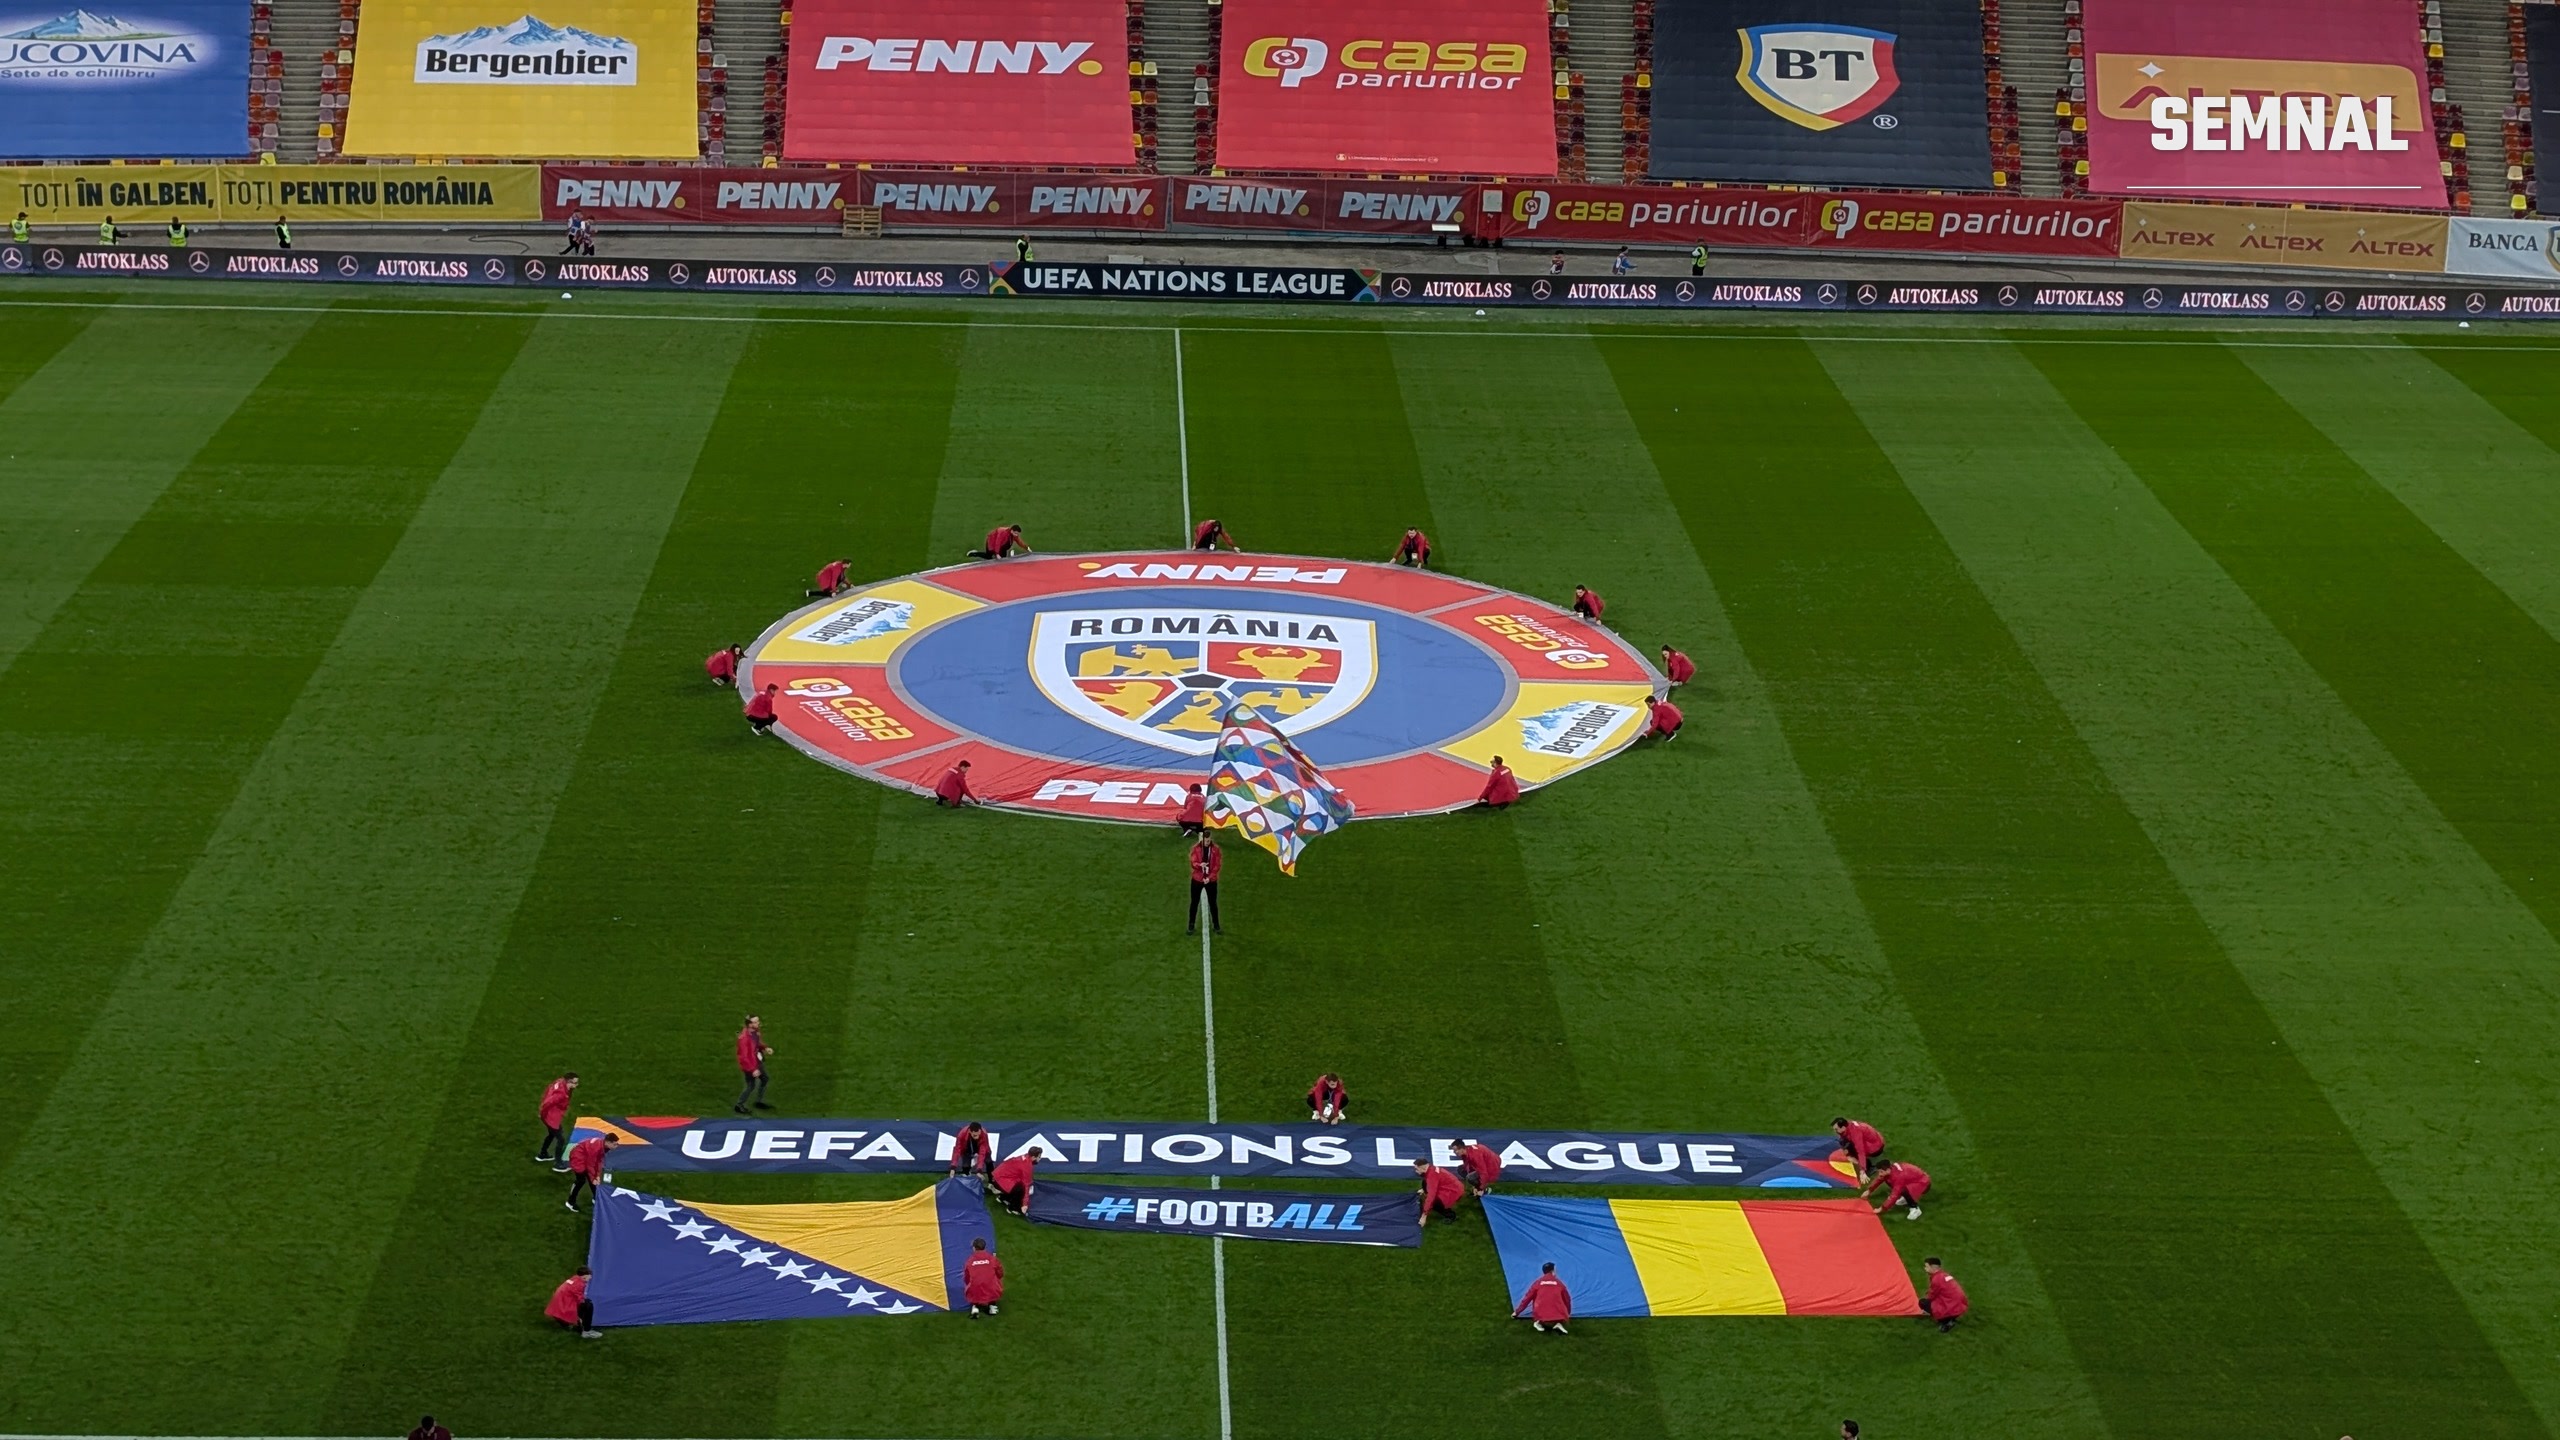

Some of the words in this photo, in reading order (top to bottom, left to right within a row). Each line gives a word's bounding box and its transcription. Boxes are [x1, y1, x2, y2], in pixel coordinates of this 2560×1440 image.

[424, 48, 628, 78] Bergenbier
[1340, 40, 1528, 73] casa
[1771, 48, 1865, 82] BT
[47, 69, 69, 78] de
[75, 69, 156, 79] echilibru
[1335, 72, 1522, 90] pariurilor
[75, 176, 103, 207] ÎN
[109, 181, 214, 209] GALBEN,
[281, 181, 377, 206] PENTRU
[383, 176, 494, 206] ROMÂNIA
[1555, 201, 1625, 222] casa
[1629, 199, 1798, 229] pariurilor
[1863, 210, 1935, 232] casa
[1939, 209, 2111, 239] pariurilor
[2468, 232, 2539, 252] BANCA
[76, 252, 169, 270] AUTOKLASS
[226, 255, 318, 274] AUTOKLASS
[376, 259, 468, 278] AUTOKLASS
[558, 263, 649, 281] AUTOKLASS
[706, 267, 797, 285] AUTOKLASS
[853, 270, 943, 288] AUTOKLASS
[1023, 267, 1093, 290] UEFA
[1102, 269, 1226, 292] NATIONS
[1236, 271, 1346, 295] LEAGUE
[1422, 280, 1512, 299] AUTOKLASS
[1567, 283, 1657, 300] AUTOKLASS
[1712, 285, 1801, 302] AUTOKLASS
[1888, 287, 1978, 305] AUTOKLASS
[2034, 289, 2124, 306] AUTOKLASS
[2179, 292, 2270, 309] AUTOKLASS
[2356, 294, 2446, 312] AUTOKLASS
[807, 600, 902, 642] Bergenbier
[1070, 613, 1339, 643] ROMÂNIA
[1473, 613, 1562, 651] casa
[1510, 613, 1590, 648] pariurilor
[799, 700, 872, 743] pariurilor
[829, 696, 915, 742] casa
[1539, 703, 1621, 755] Bergenbier
[681, 1129, 916, 1161] UEFA
[1081, 1196, 1366, 1231] #FOOTBALL
